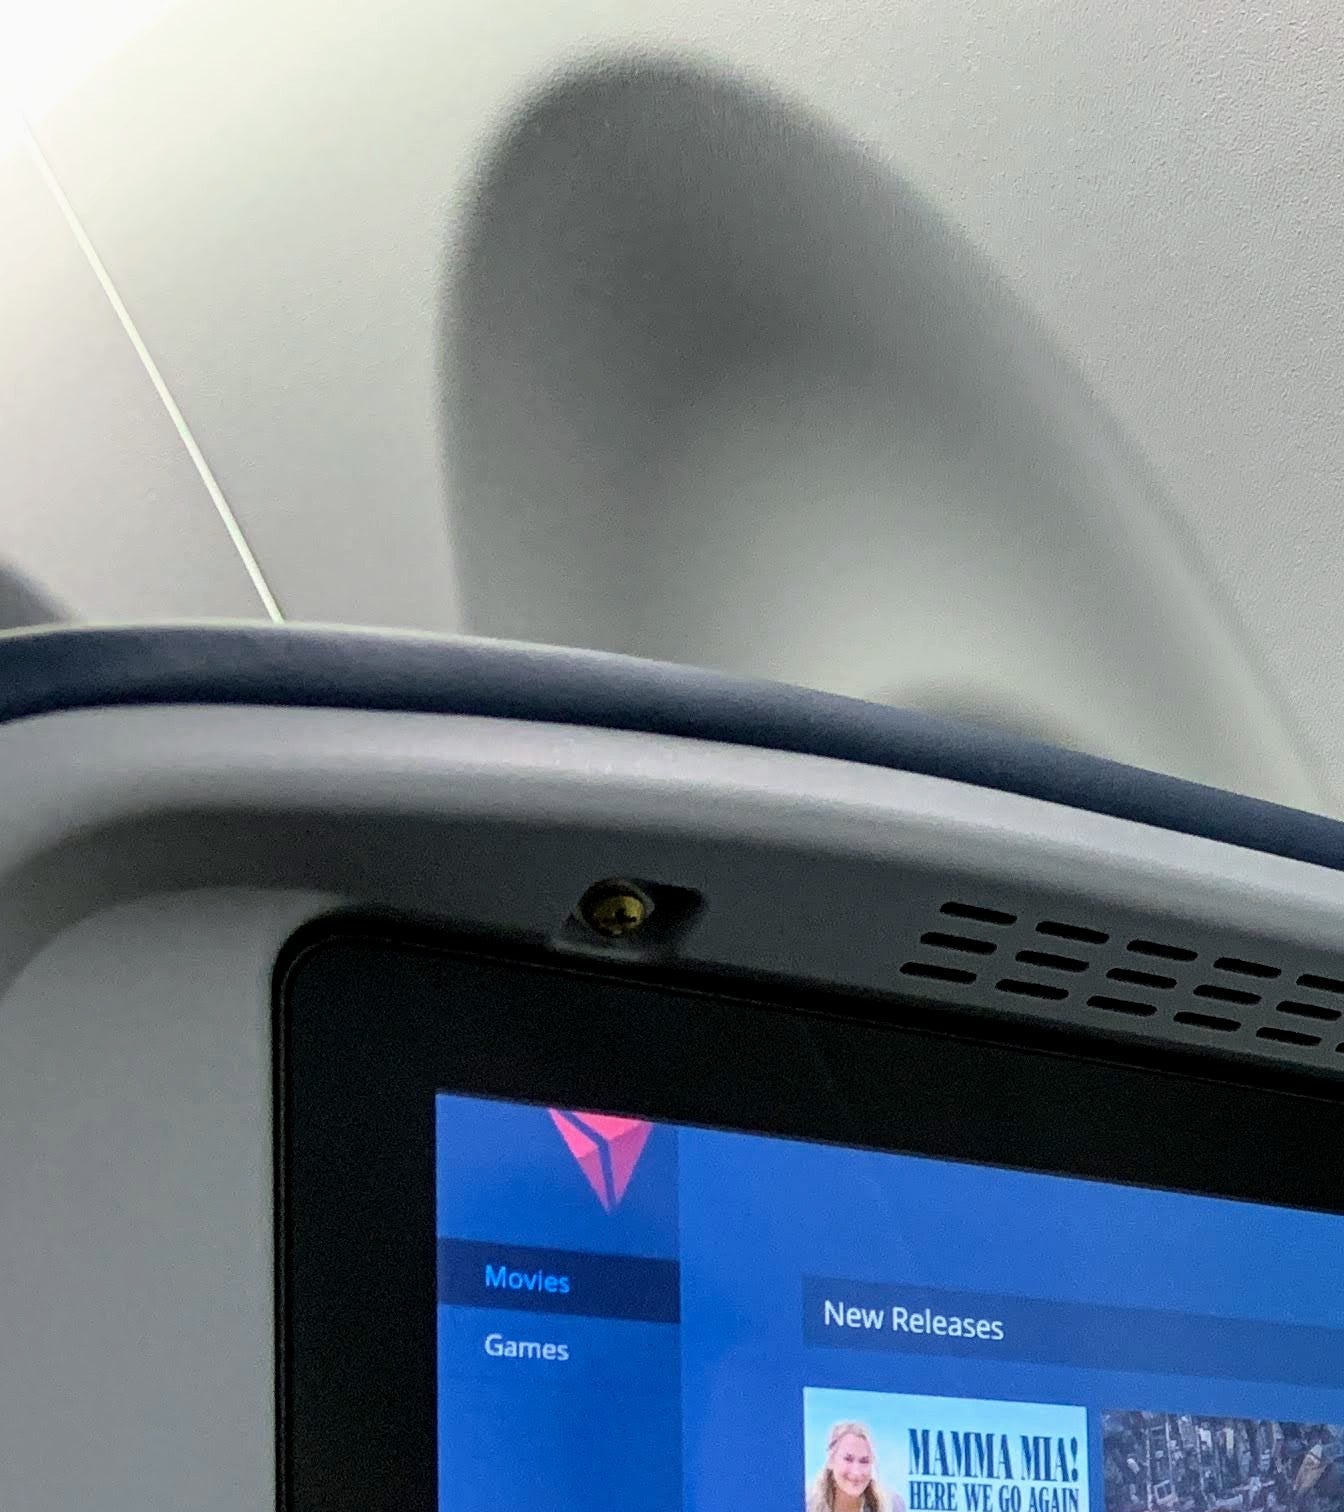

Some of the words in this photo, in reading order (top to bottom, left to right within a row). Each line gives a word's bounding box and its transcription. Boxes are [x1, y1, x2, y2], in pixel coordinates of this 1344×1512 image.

[484, 1264, 570, 1294] Movies
[824, 1299, 884, 1330] New
[892, 1306, 1005, 1341] Releases
[484, 1332, 569, 1361] Games
[908, 1428, 1013, 1480] MAMMA
[1020, 1436, 1079, 1482] MIA!
[909, 1480, 957, 1511] HERE
[963, 1483, 993, 1512] WE
